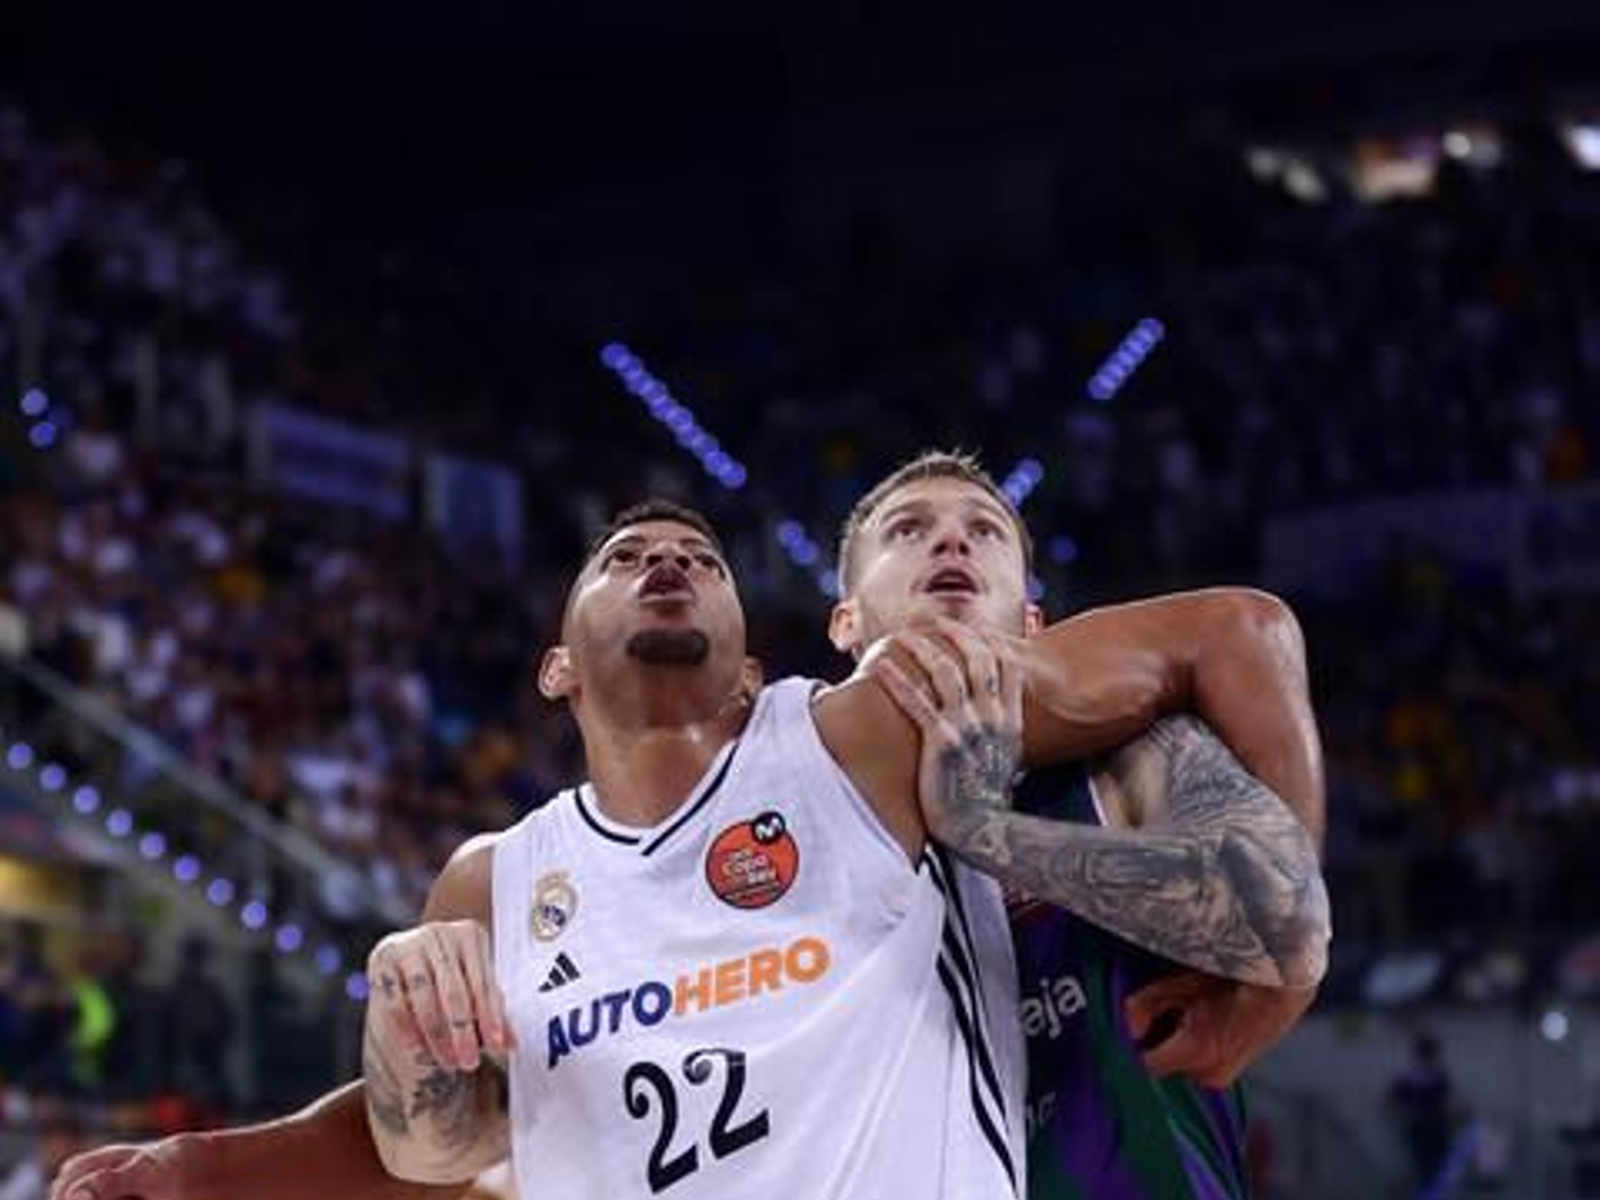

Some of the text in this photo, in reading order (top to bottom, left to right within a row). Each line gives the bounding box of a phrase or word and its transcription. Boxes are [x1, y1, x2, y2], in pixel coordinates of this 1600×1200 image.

[546, 937, 830, 1070] AUTOHERO
[1021, 975, 1087, 1039] aja
[623, 1048, 770, 1195] 22
